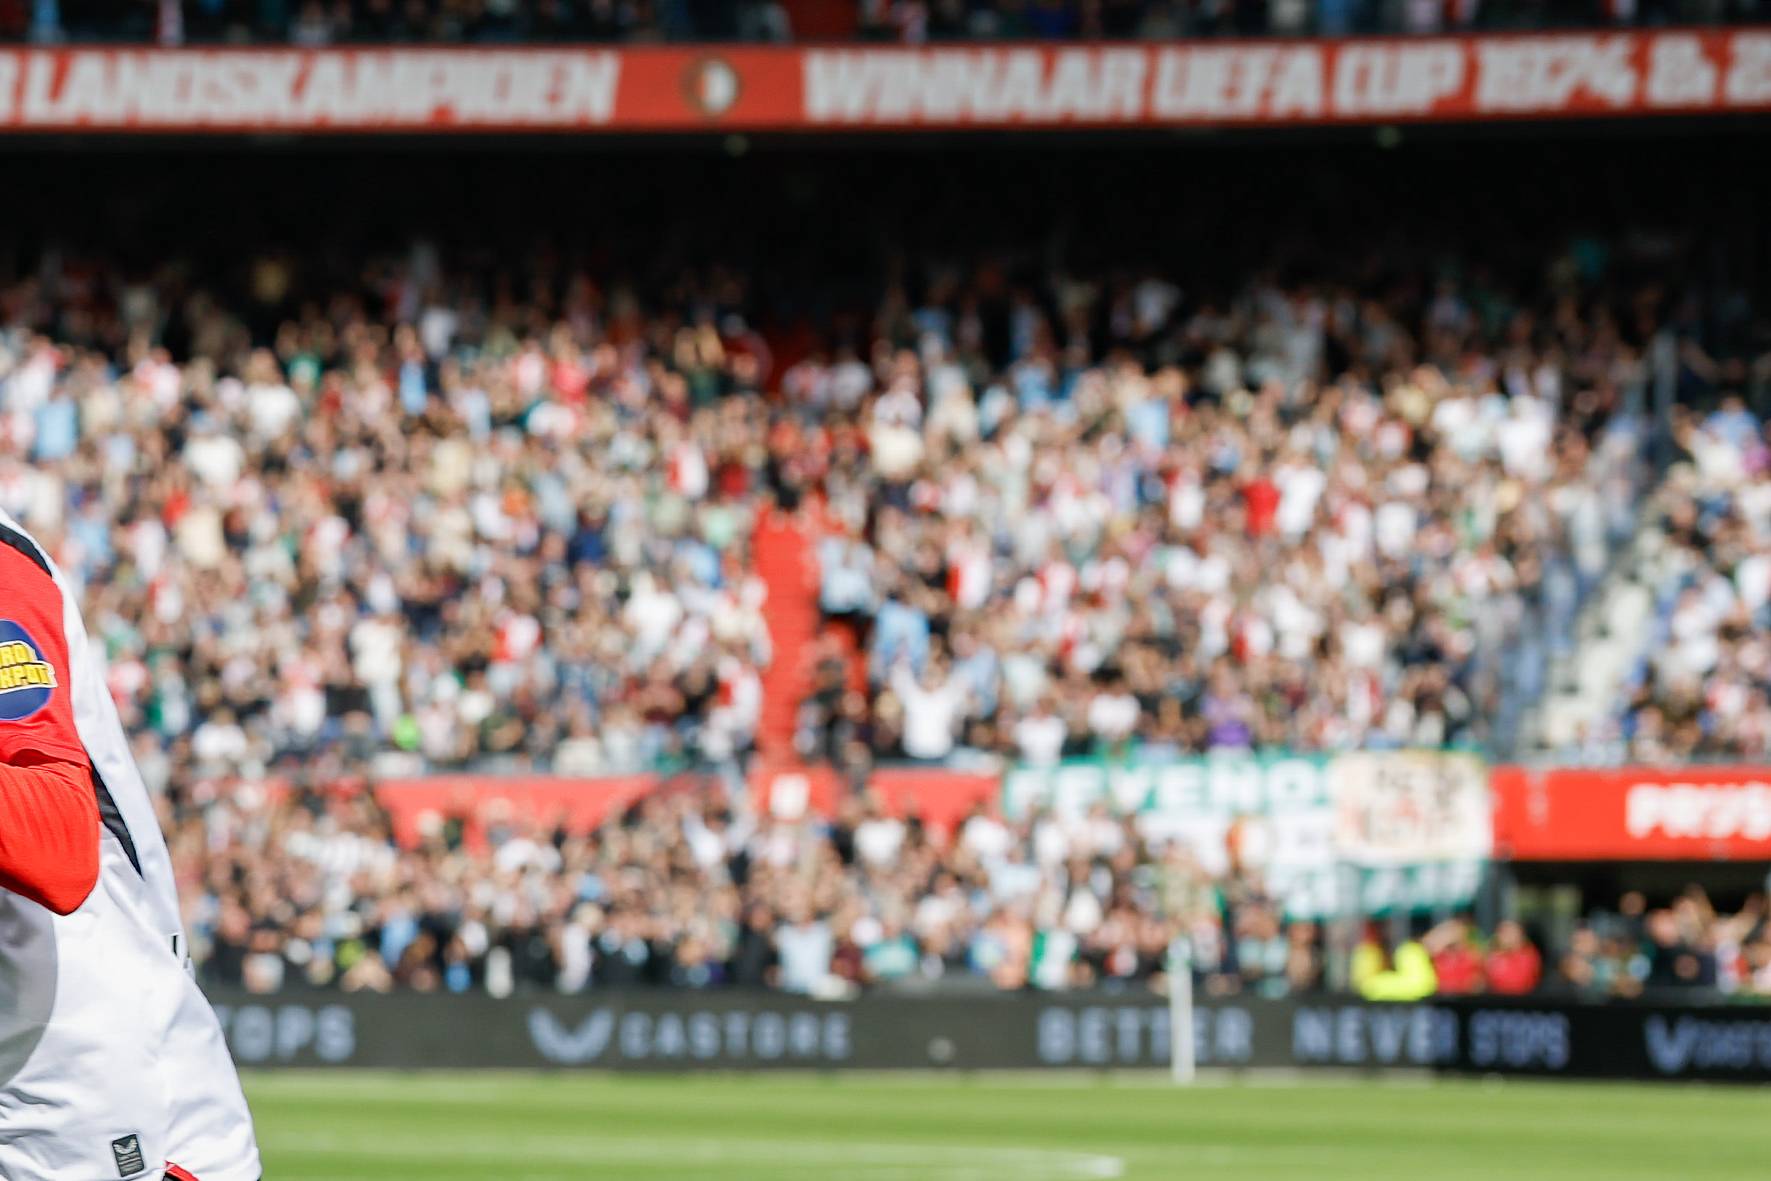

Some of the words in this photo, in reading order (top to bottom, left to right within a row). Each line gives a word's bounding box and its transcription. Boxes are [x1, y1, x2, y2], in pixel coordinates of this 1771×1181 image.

[22, 52, 618, 123] LANDSKAMPIOEN
[803, 50, 1144, 120] WINNAAR
[1152, 46, 1324, 117] UEFA
[1334, 42, 1465, 114] CUP
[619, 1011, 850, 1059] CASTORE
[1292, 1006, 1459, 1064] NEVER
